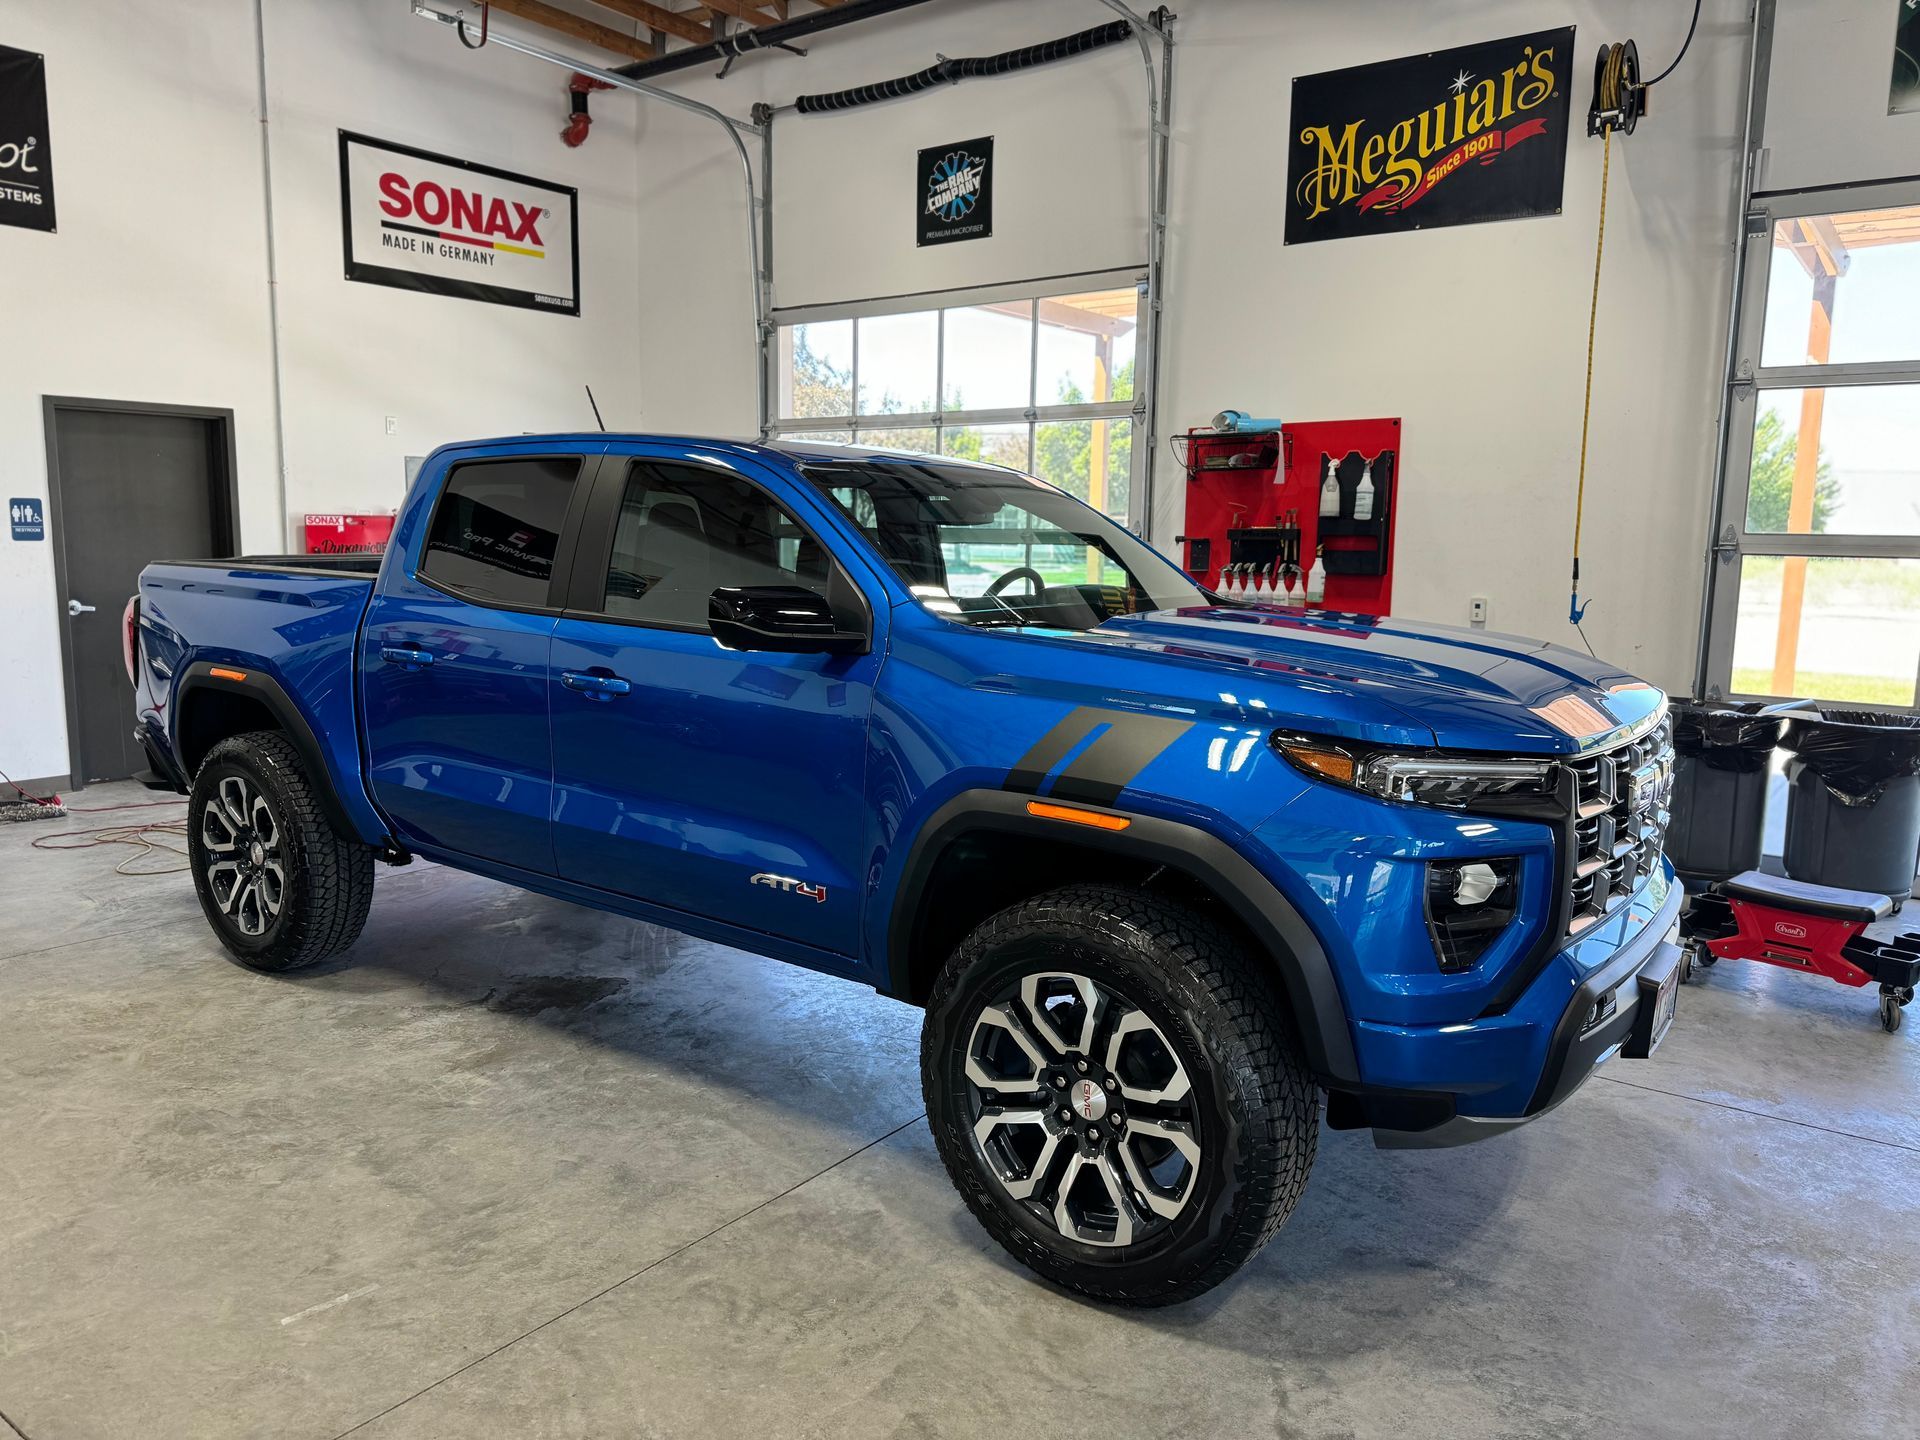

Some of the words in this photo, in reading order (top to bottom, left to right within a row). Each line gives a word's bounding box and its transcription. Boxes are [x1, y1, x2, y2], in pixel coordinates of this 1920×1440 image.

[1296, 46, 1555, 220] Meguiar's
[1426, 152, 1461, 189] Since
[1463, 133, 1494, 160] 1901
[928, 176, 980, 211] COMPANY
[935, 181, 949, 193] THE
[947, 166, 983, 190] RAG
[379, 172, 544, 247] SONAX
[382, 233, 417, 251] MADE
[421, 240, 435, 255] IN
[439, 244, 495, 266] GERMANY
[926, 229, 951, 239] PREMIUM
[307, 516, 340, 525] SONAX
[750, 872, 827, 904] AT4
[1083, 1083, 1092, 1118] GMC
